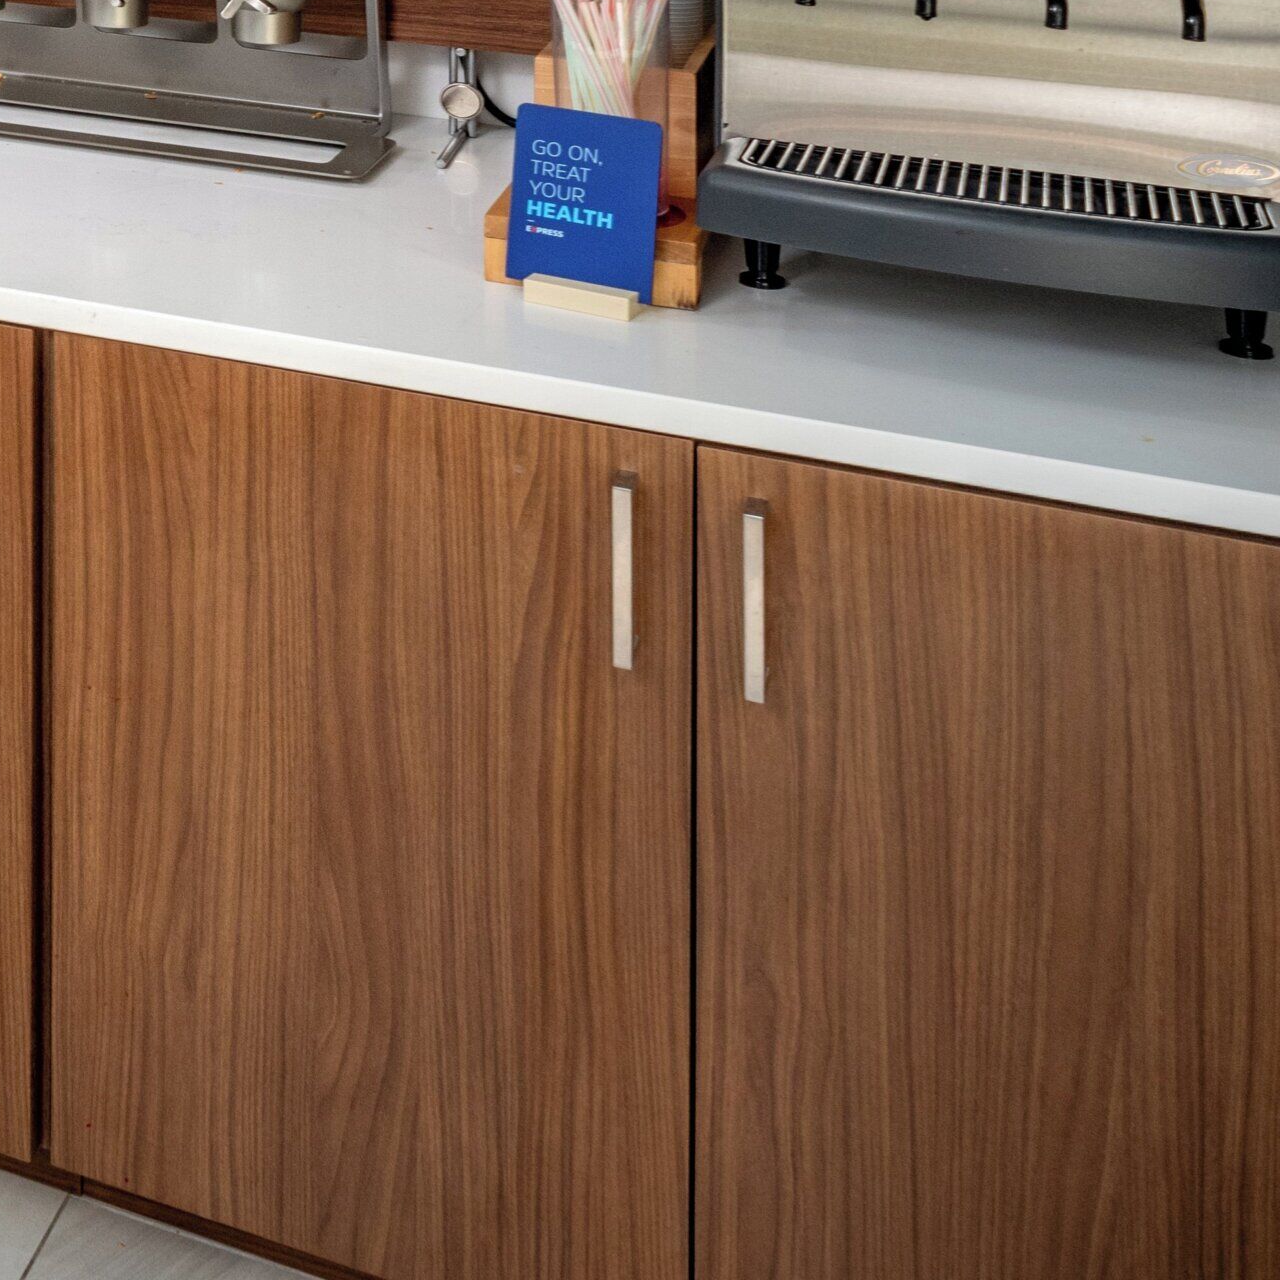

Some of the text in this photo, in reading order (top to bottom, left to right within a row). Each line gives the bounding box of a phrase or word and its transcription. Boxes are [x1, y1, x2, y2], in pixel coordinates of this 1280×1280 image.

[531, 139, 603, 166] GO ON.
[530, 159, 592, 183] TREAT
[529, 180, 586, 204] YOUR
[526, 199, 613, 230] HEALTH
[525, 225, 564, 238] EXPRESS
